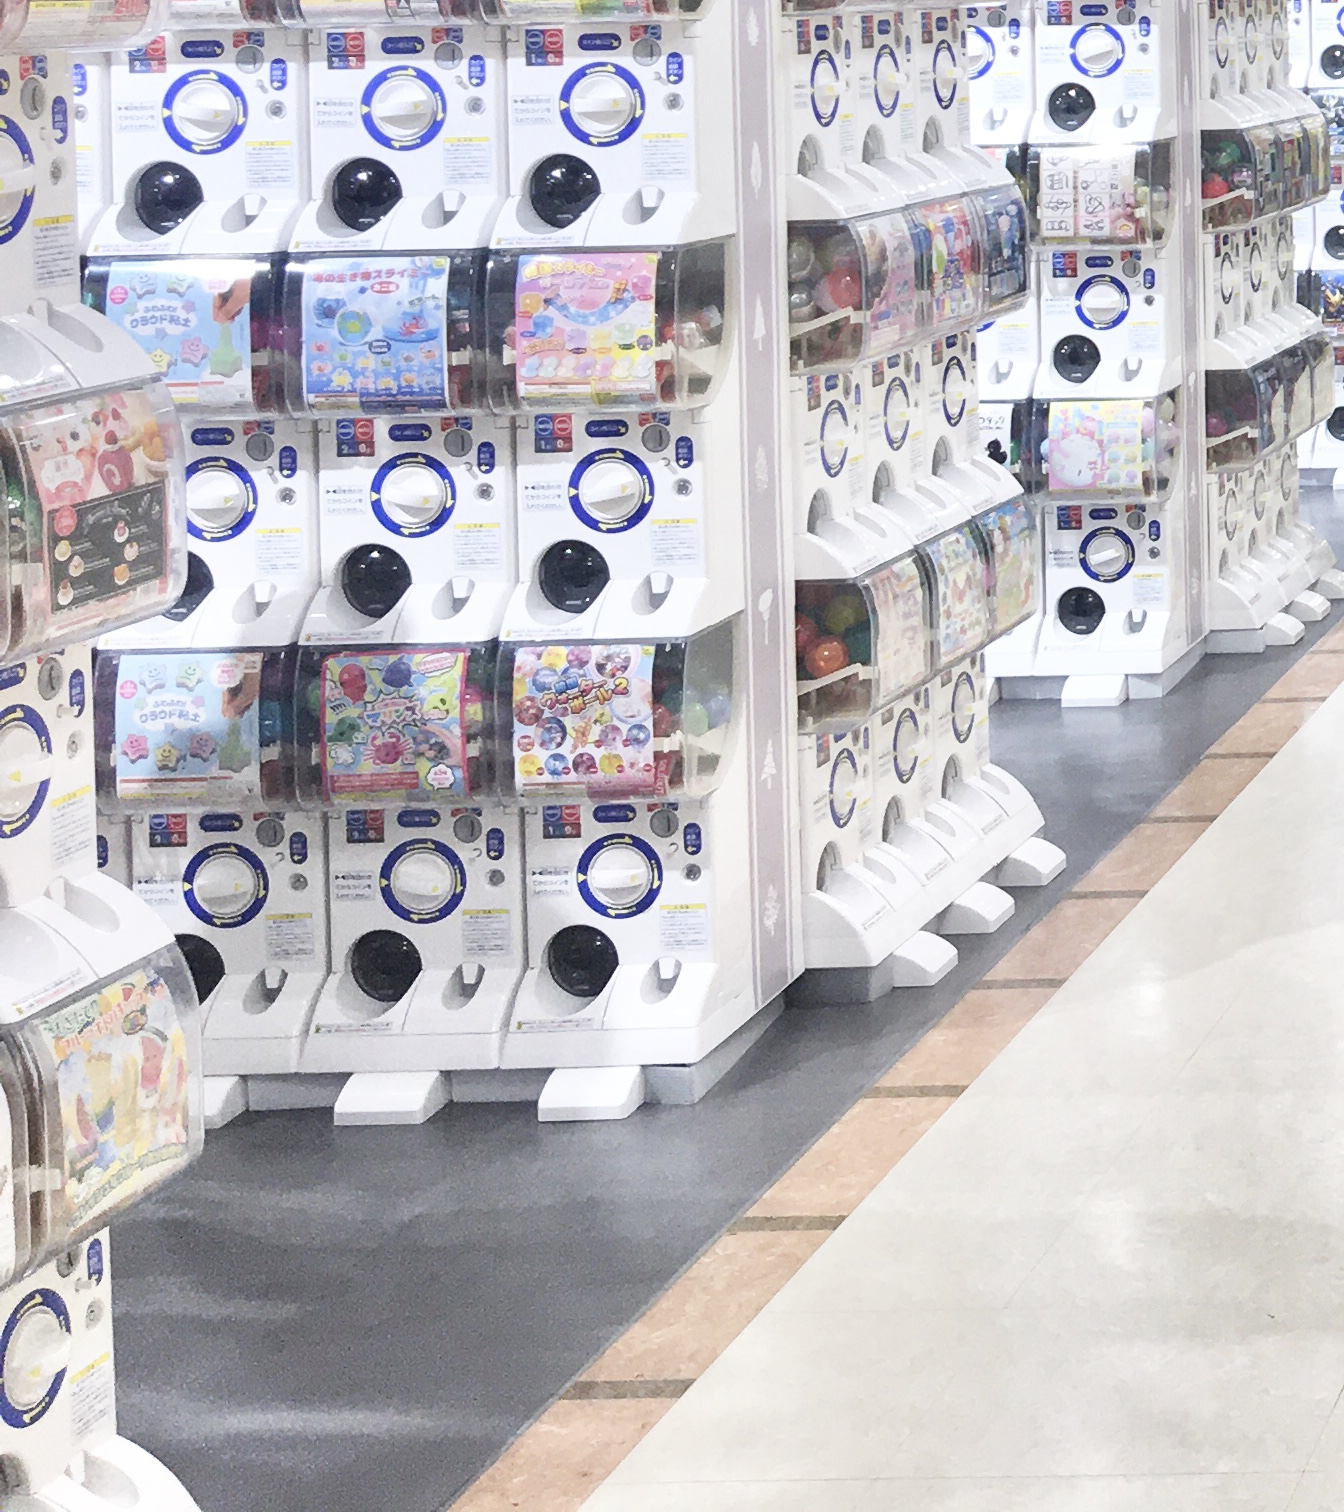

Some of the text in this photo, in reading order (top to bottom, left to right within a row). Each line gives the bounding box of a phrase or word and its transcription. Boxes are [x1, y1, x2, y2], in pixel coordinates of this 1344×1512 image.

[130, 313, 191, 329] クラウド粘土
